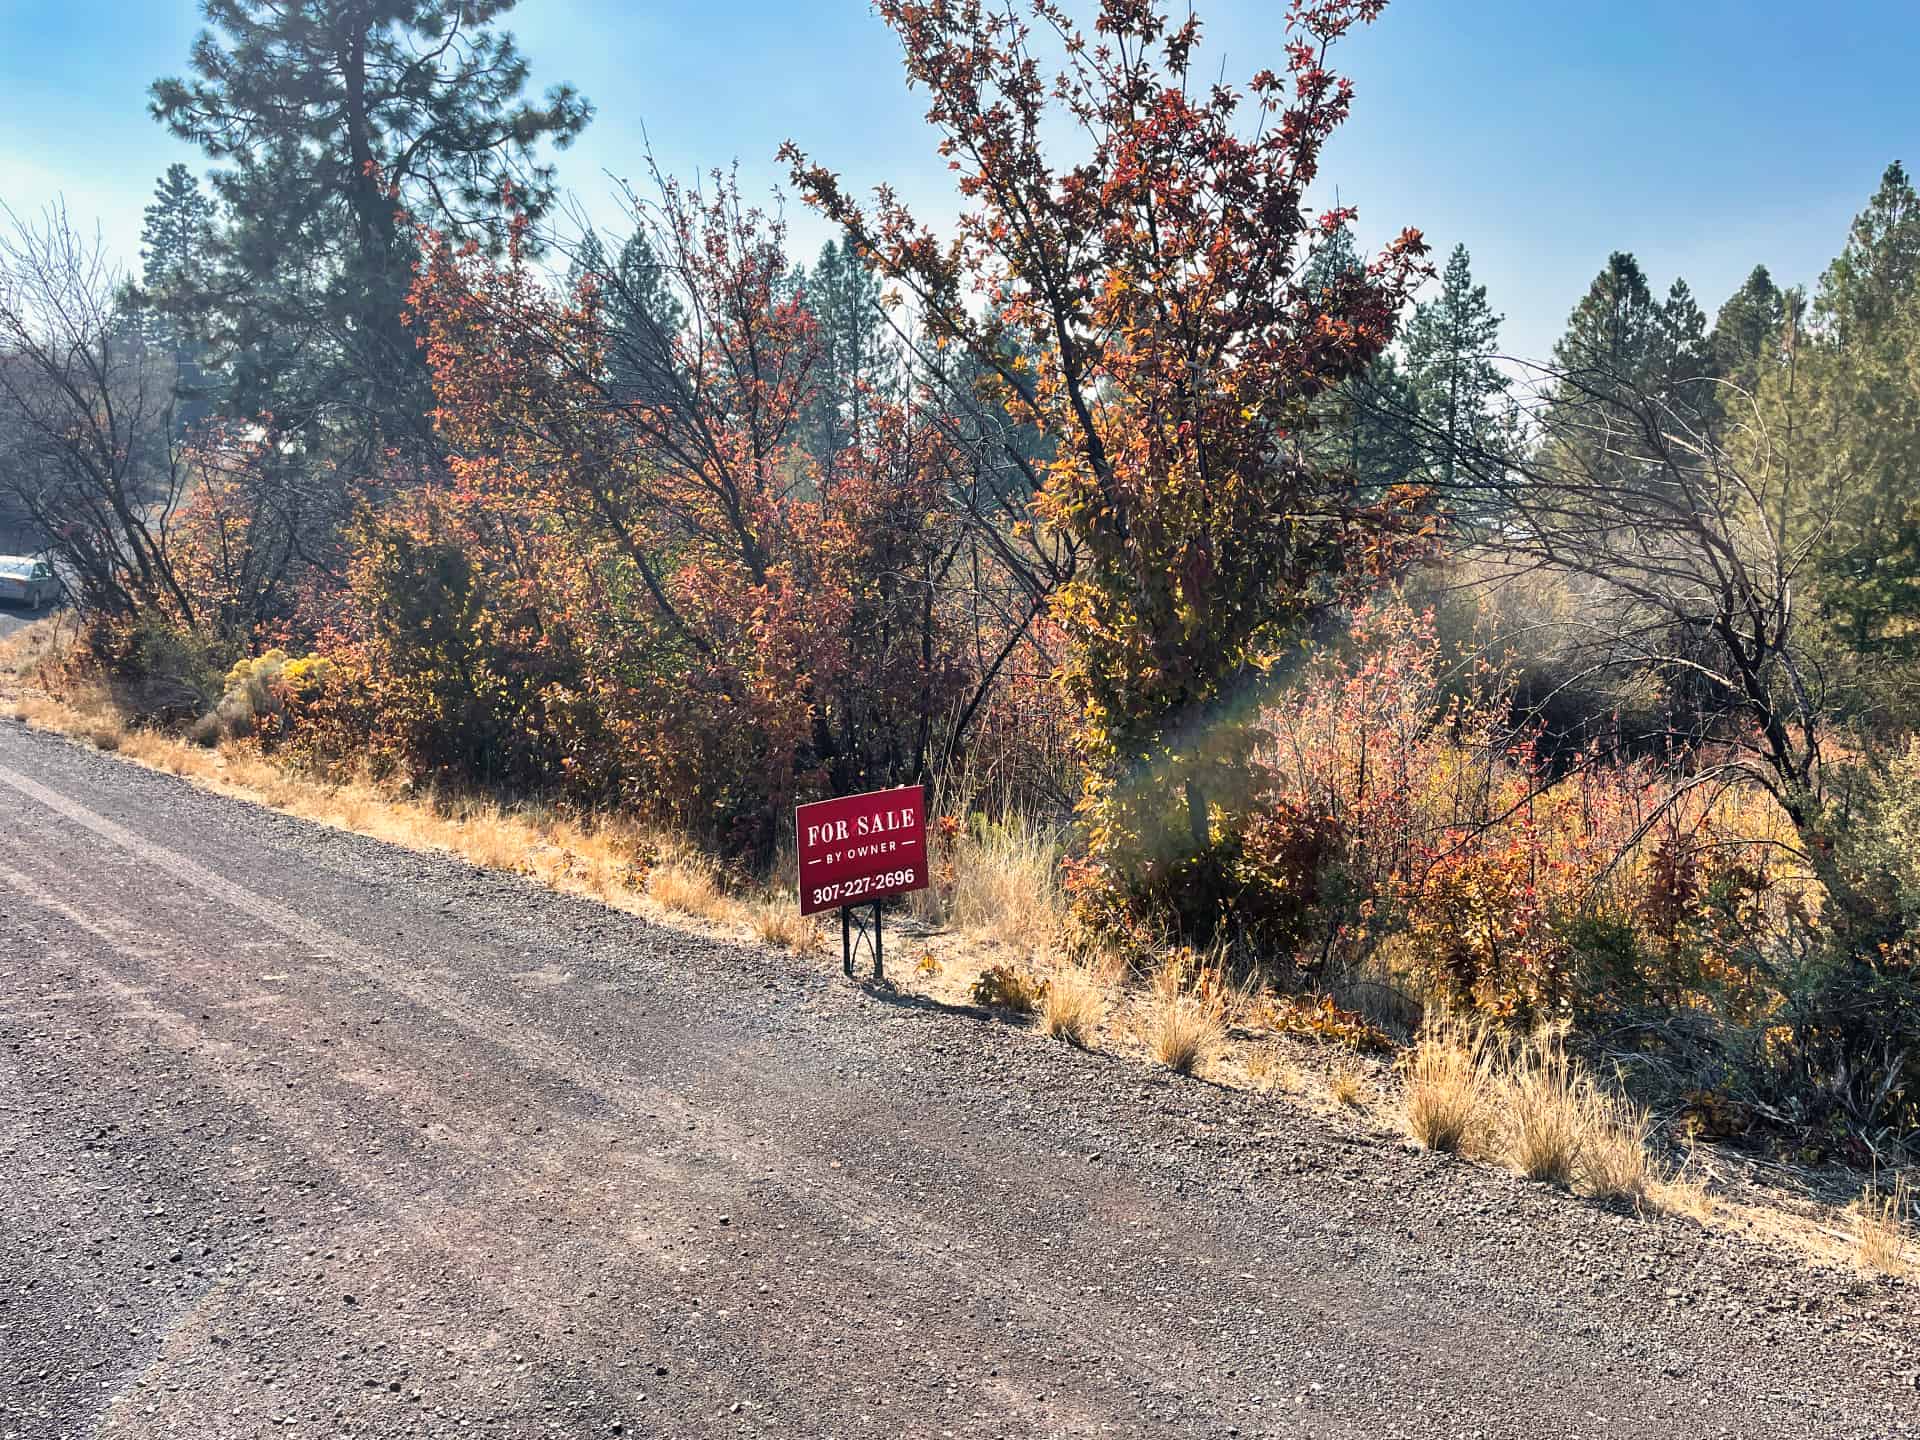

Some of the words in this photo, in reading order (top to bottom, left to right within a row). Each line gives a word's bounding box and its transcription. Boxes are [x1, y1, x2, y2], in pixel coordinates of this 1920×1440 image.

[807, 820, 849, 847] FOR
[857, 808, 915, 836] SALE
[826, 851, 842, 864] BY
[847, 841, 896, 859] OWNER
[813, 868, 915, 905] 307-227-2696
